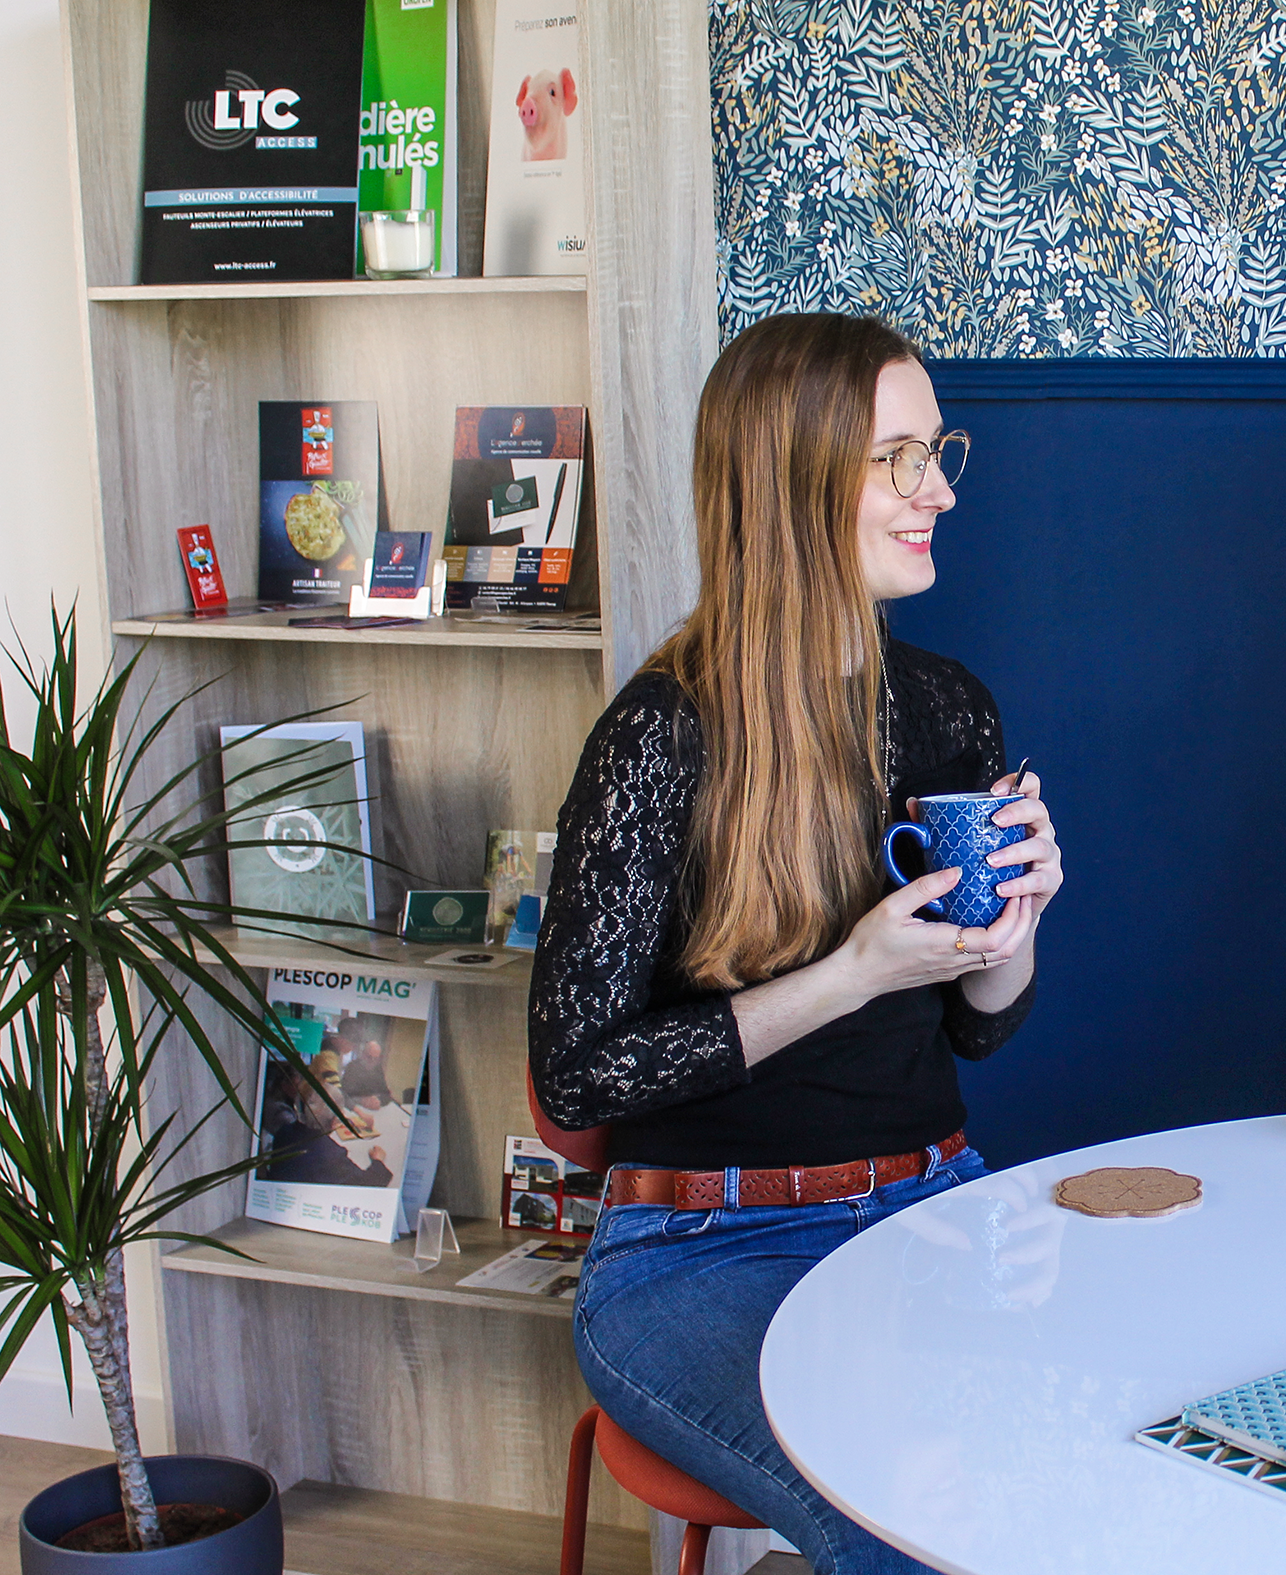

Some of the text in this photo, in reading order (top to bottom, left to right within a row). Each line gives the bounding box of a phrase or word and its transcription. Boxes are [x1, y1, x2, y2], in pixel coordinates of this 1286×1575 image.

[545, 18, 558, 28] son
[213, 88, 301, 130] LTC
[360, 99, 436, 136] dière
[257, 137, 317, 149] ACCESS
[358, 132, 439, 171] nulés
[178, 188, 319, 203] SOLUTIONS D'ACCESSIBILITÉ
[162, 212, 193, 221] FAUTEUILS
[557, 235, 586, 251] wisiu
[213, 260, 277, 271] www.ltc-access.fr
[292, 579, 316, 588] ARTISAN
[274, 967, 416, 999] PLESCOP MAG'
